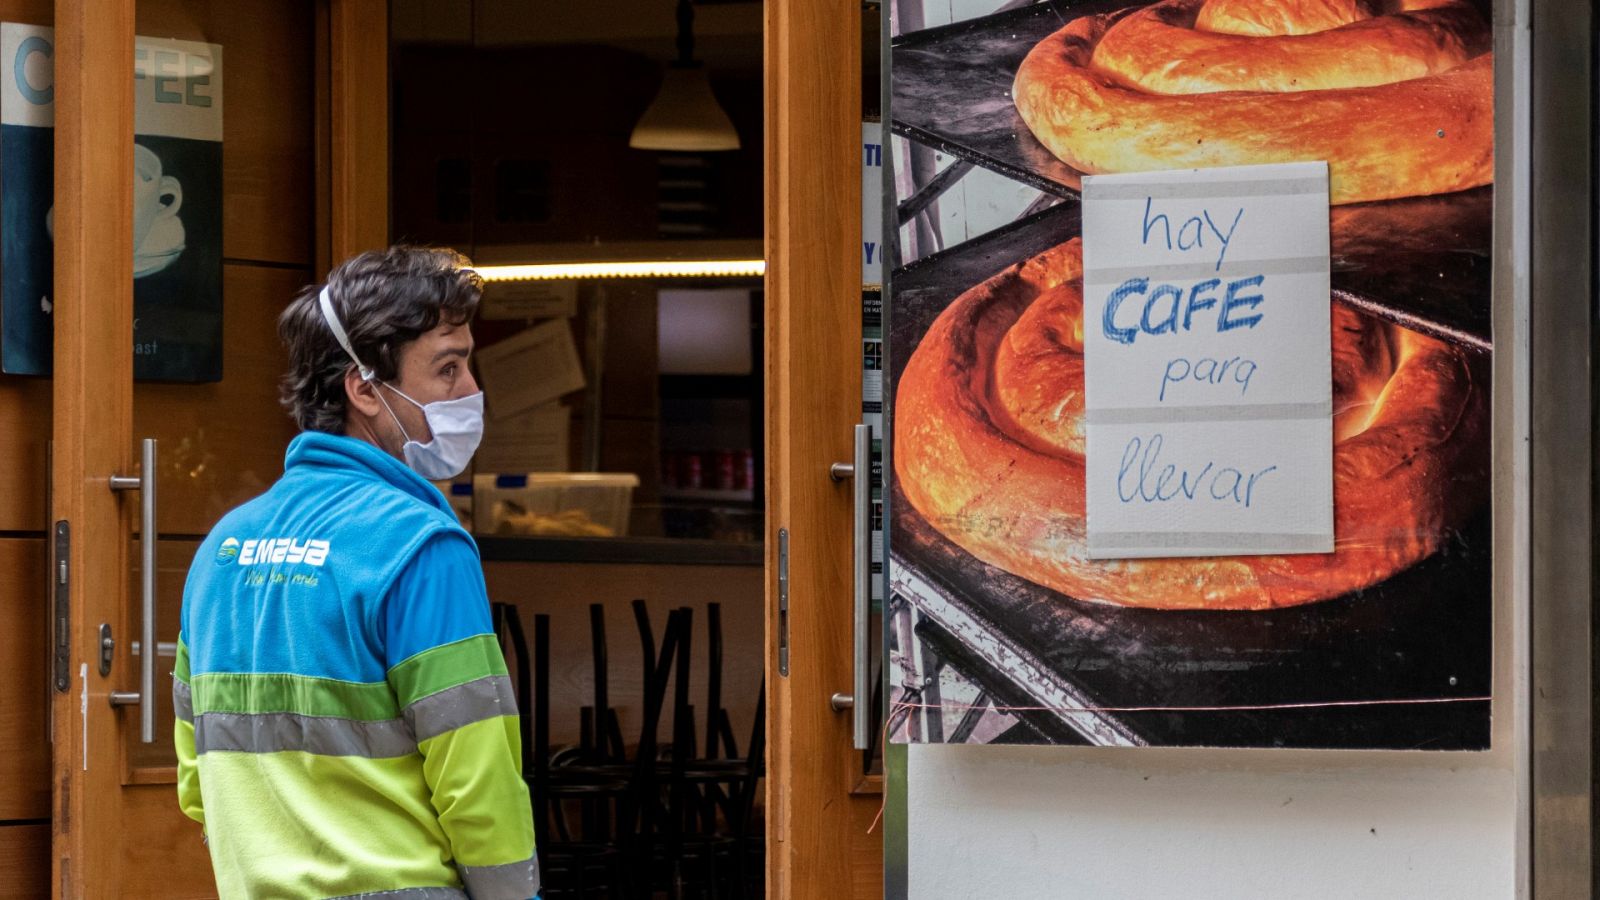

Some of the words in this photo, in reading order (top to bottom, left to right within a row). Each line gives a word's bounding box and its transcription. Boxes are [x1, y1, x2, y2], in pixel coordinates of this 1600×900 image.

[1142, 196, 1244, 271] hay
[1159, 355, 1257, 402] para
[1118, 434, 1277, 507] llevar
